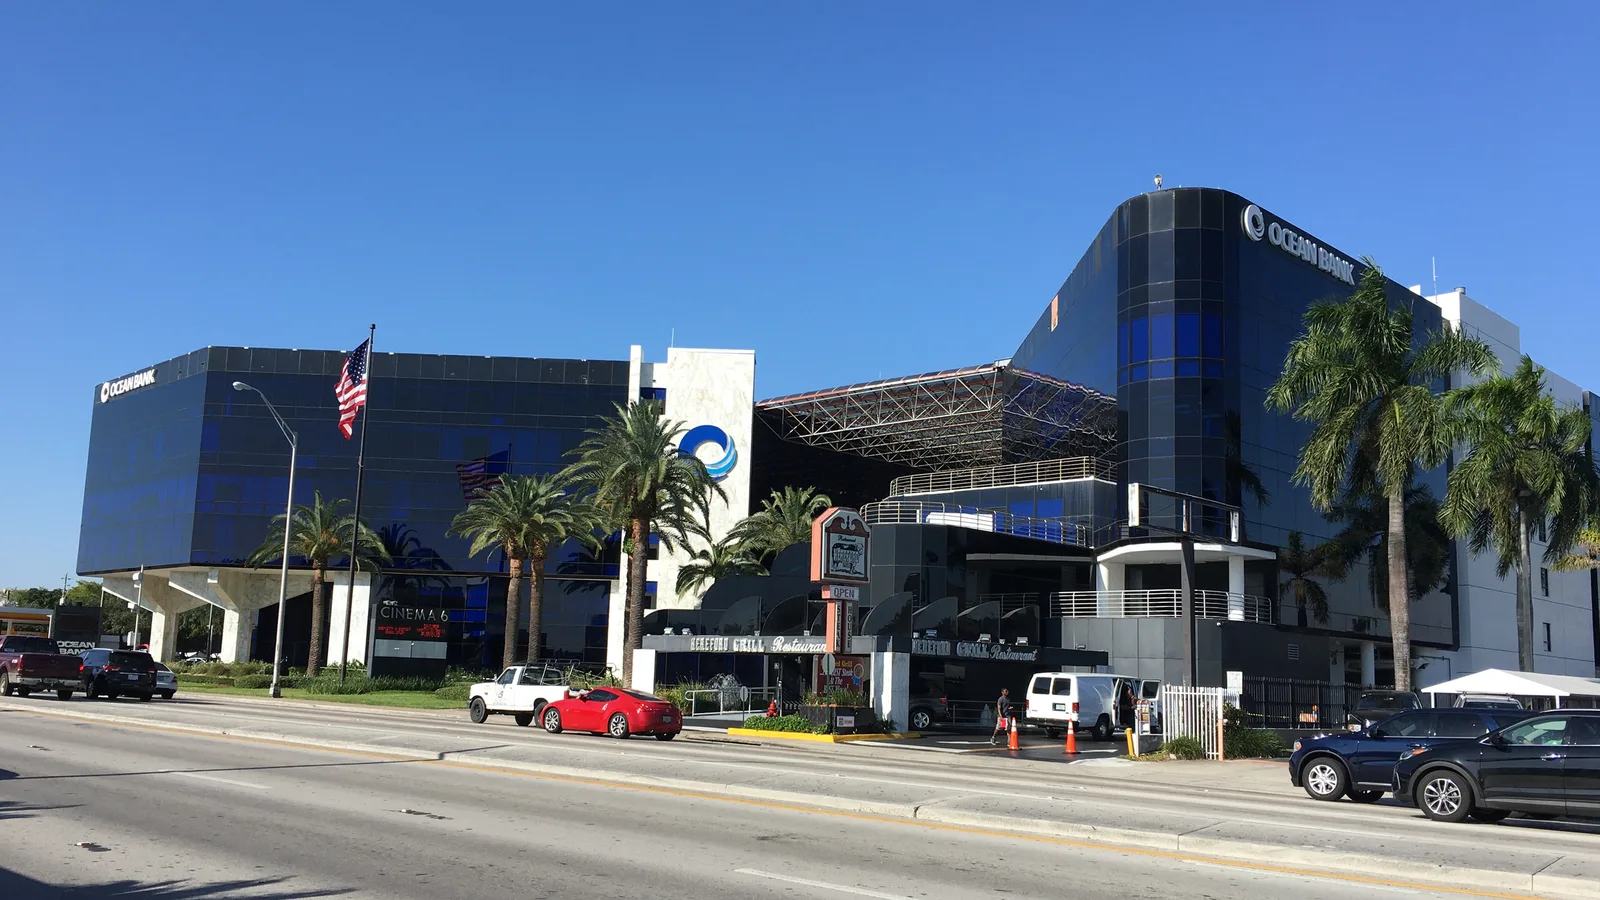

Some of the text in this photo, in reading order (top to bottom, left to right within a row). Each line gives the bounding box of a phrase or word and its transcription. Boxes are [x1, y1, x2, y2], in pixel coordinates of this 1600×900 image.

[1268, 221, 1355, 285] OCEAN BANK
[110, 369, 156, 397] OCEAN BANK
[833, 587, 855, 598] OPEN
[380, 607, 448, 622] CINEMA 6
[57, 640, 96, 648] OCEAN
[690, 635, 826, 653] HEREFORD GRILL Restauran
[989, 645, 1037, 661] Restaurant
